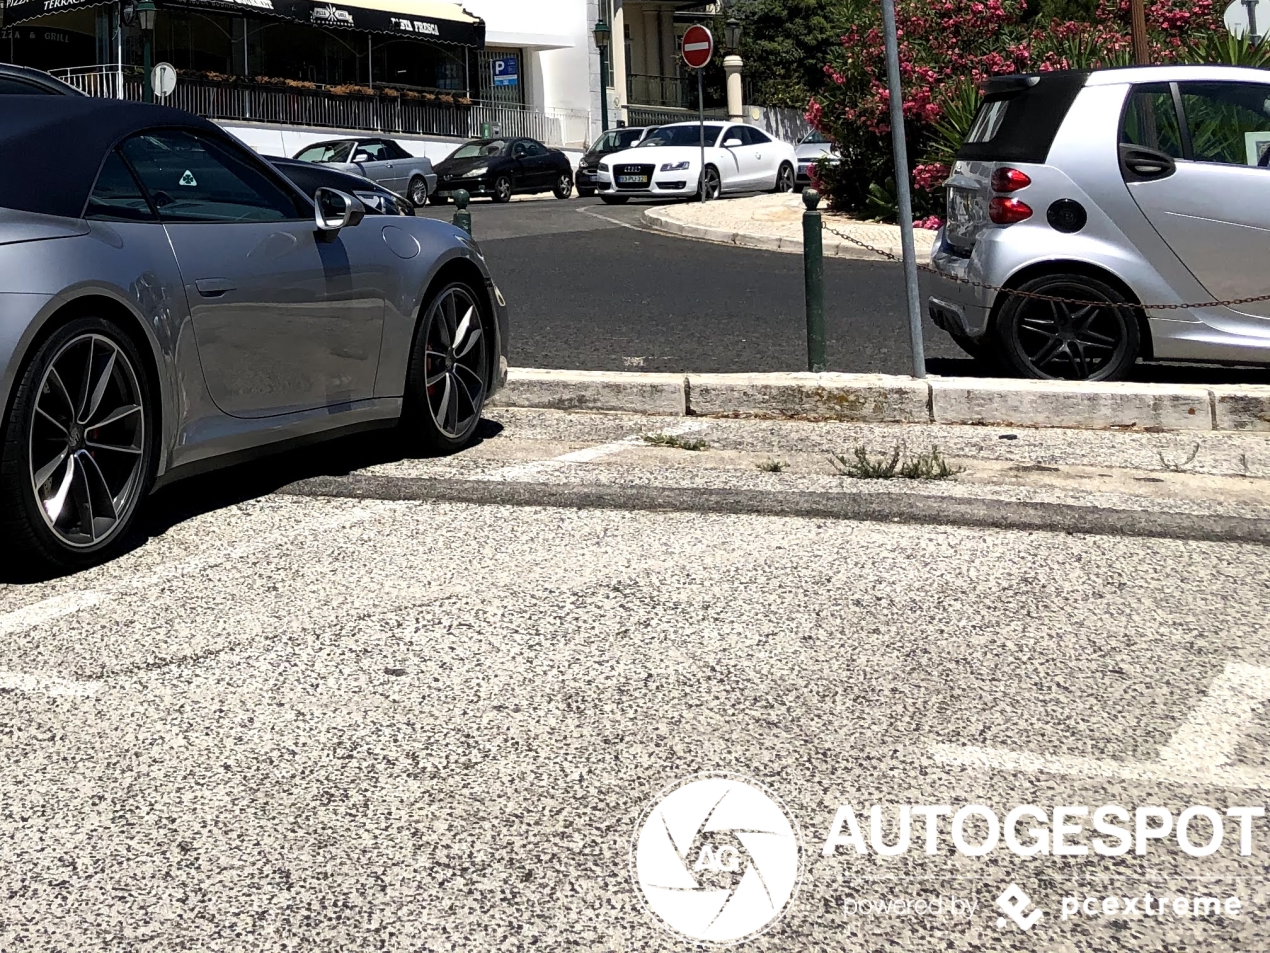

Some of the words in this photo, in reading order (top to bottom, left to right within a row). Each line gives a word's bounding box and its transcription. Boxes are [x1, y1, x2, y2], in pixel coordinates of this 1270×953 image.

[414, 21, 440, 36] FRESCA
[44, 32, 69, 43] GRILL
[495, 60, 505, 75] P
